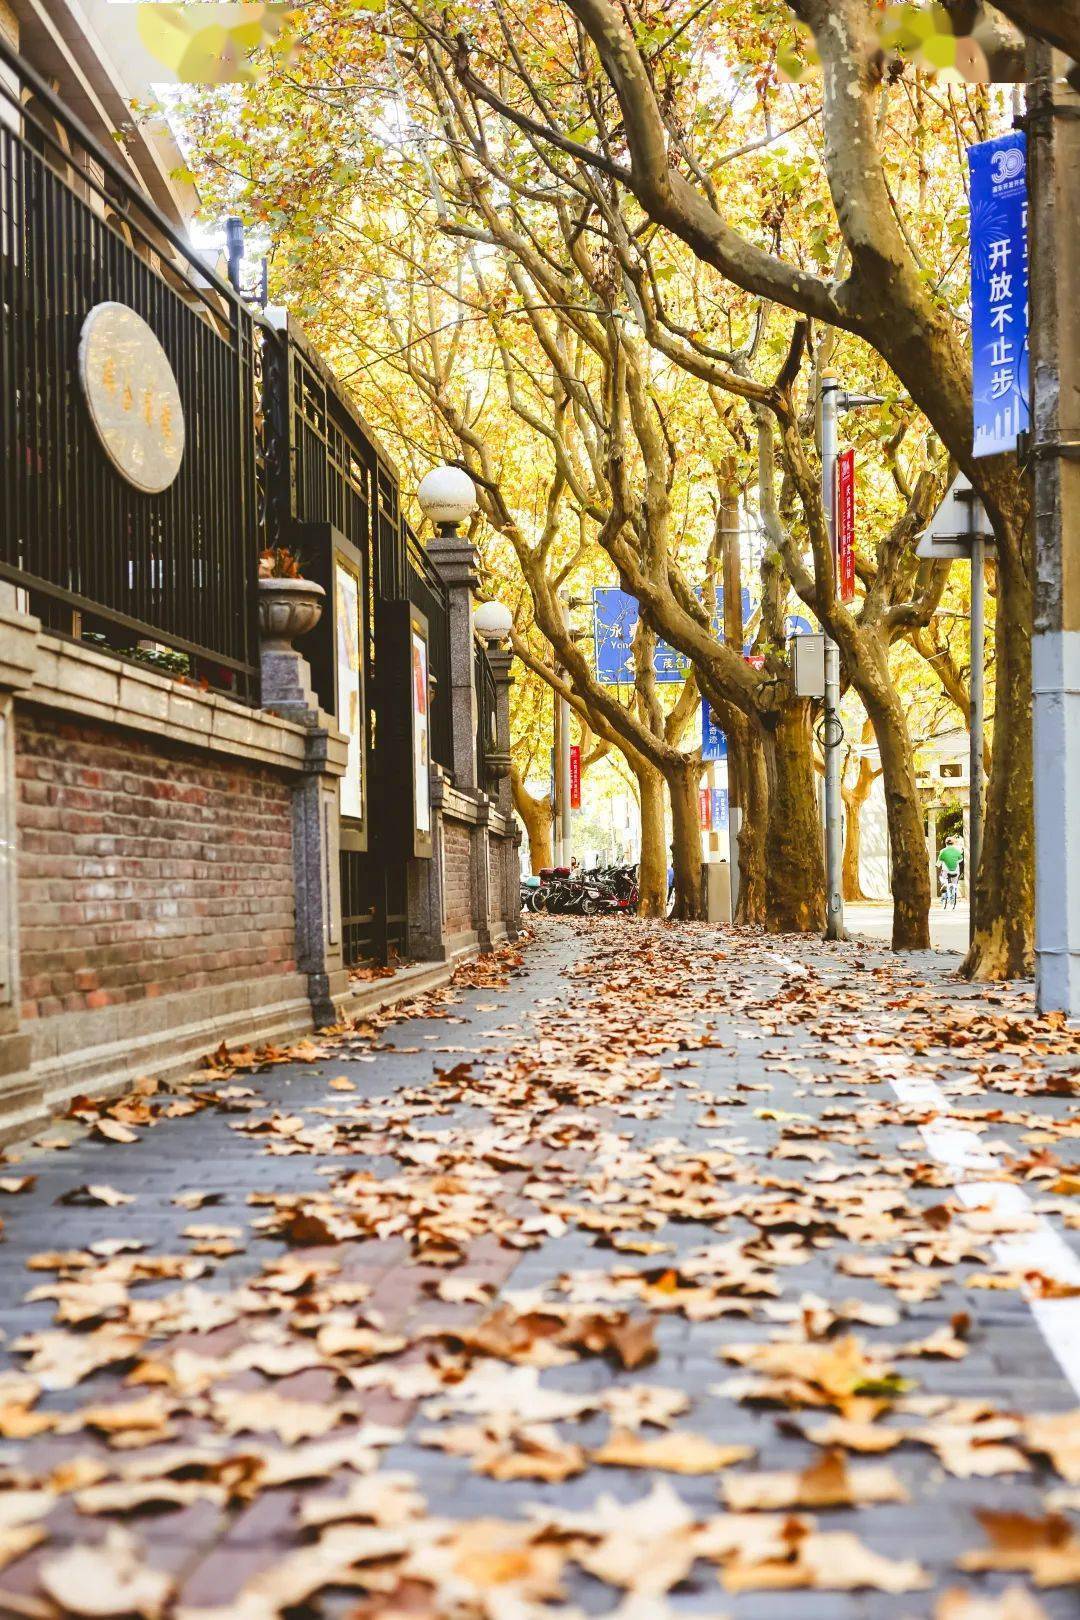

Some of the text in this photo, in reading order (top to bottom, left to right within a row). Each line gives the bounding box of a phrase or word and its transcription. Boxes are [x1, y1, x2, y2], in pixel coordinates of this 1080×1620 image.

[991, 148, 1025, 183] 30
[988, 238, 1015, 400] 开放不止步
